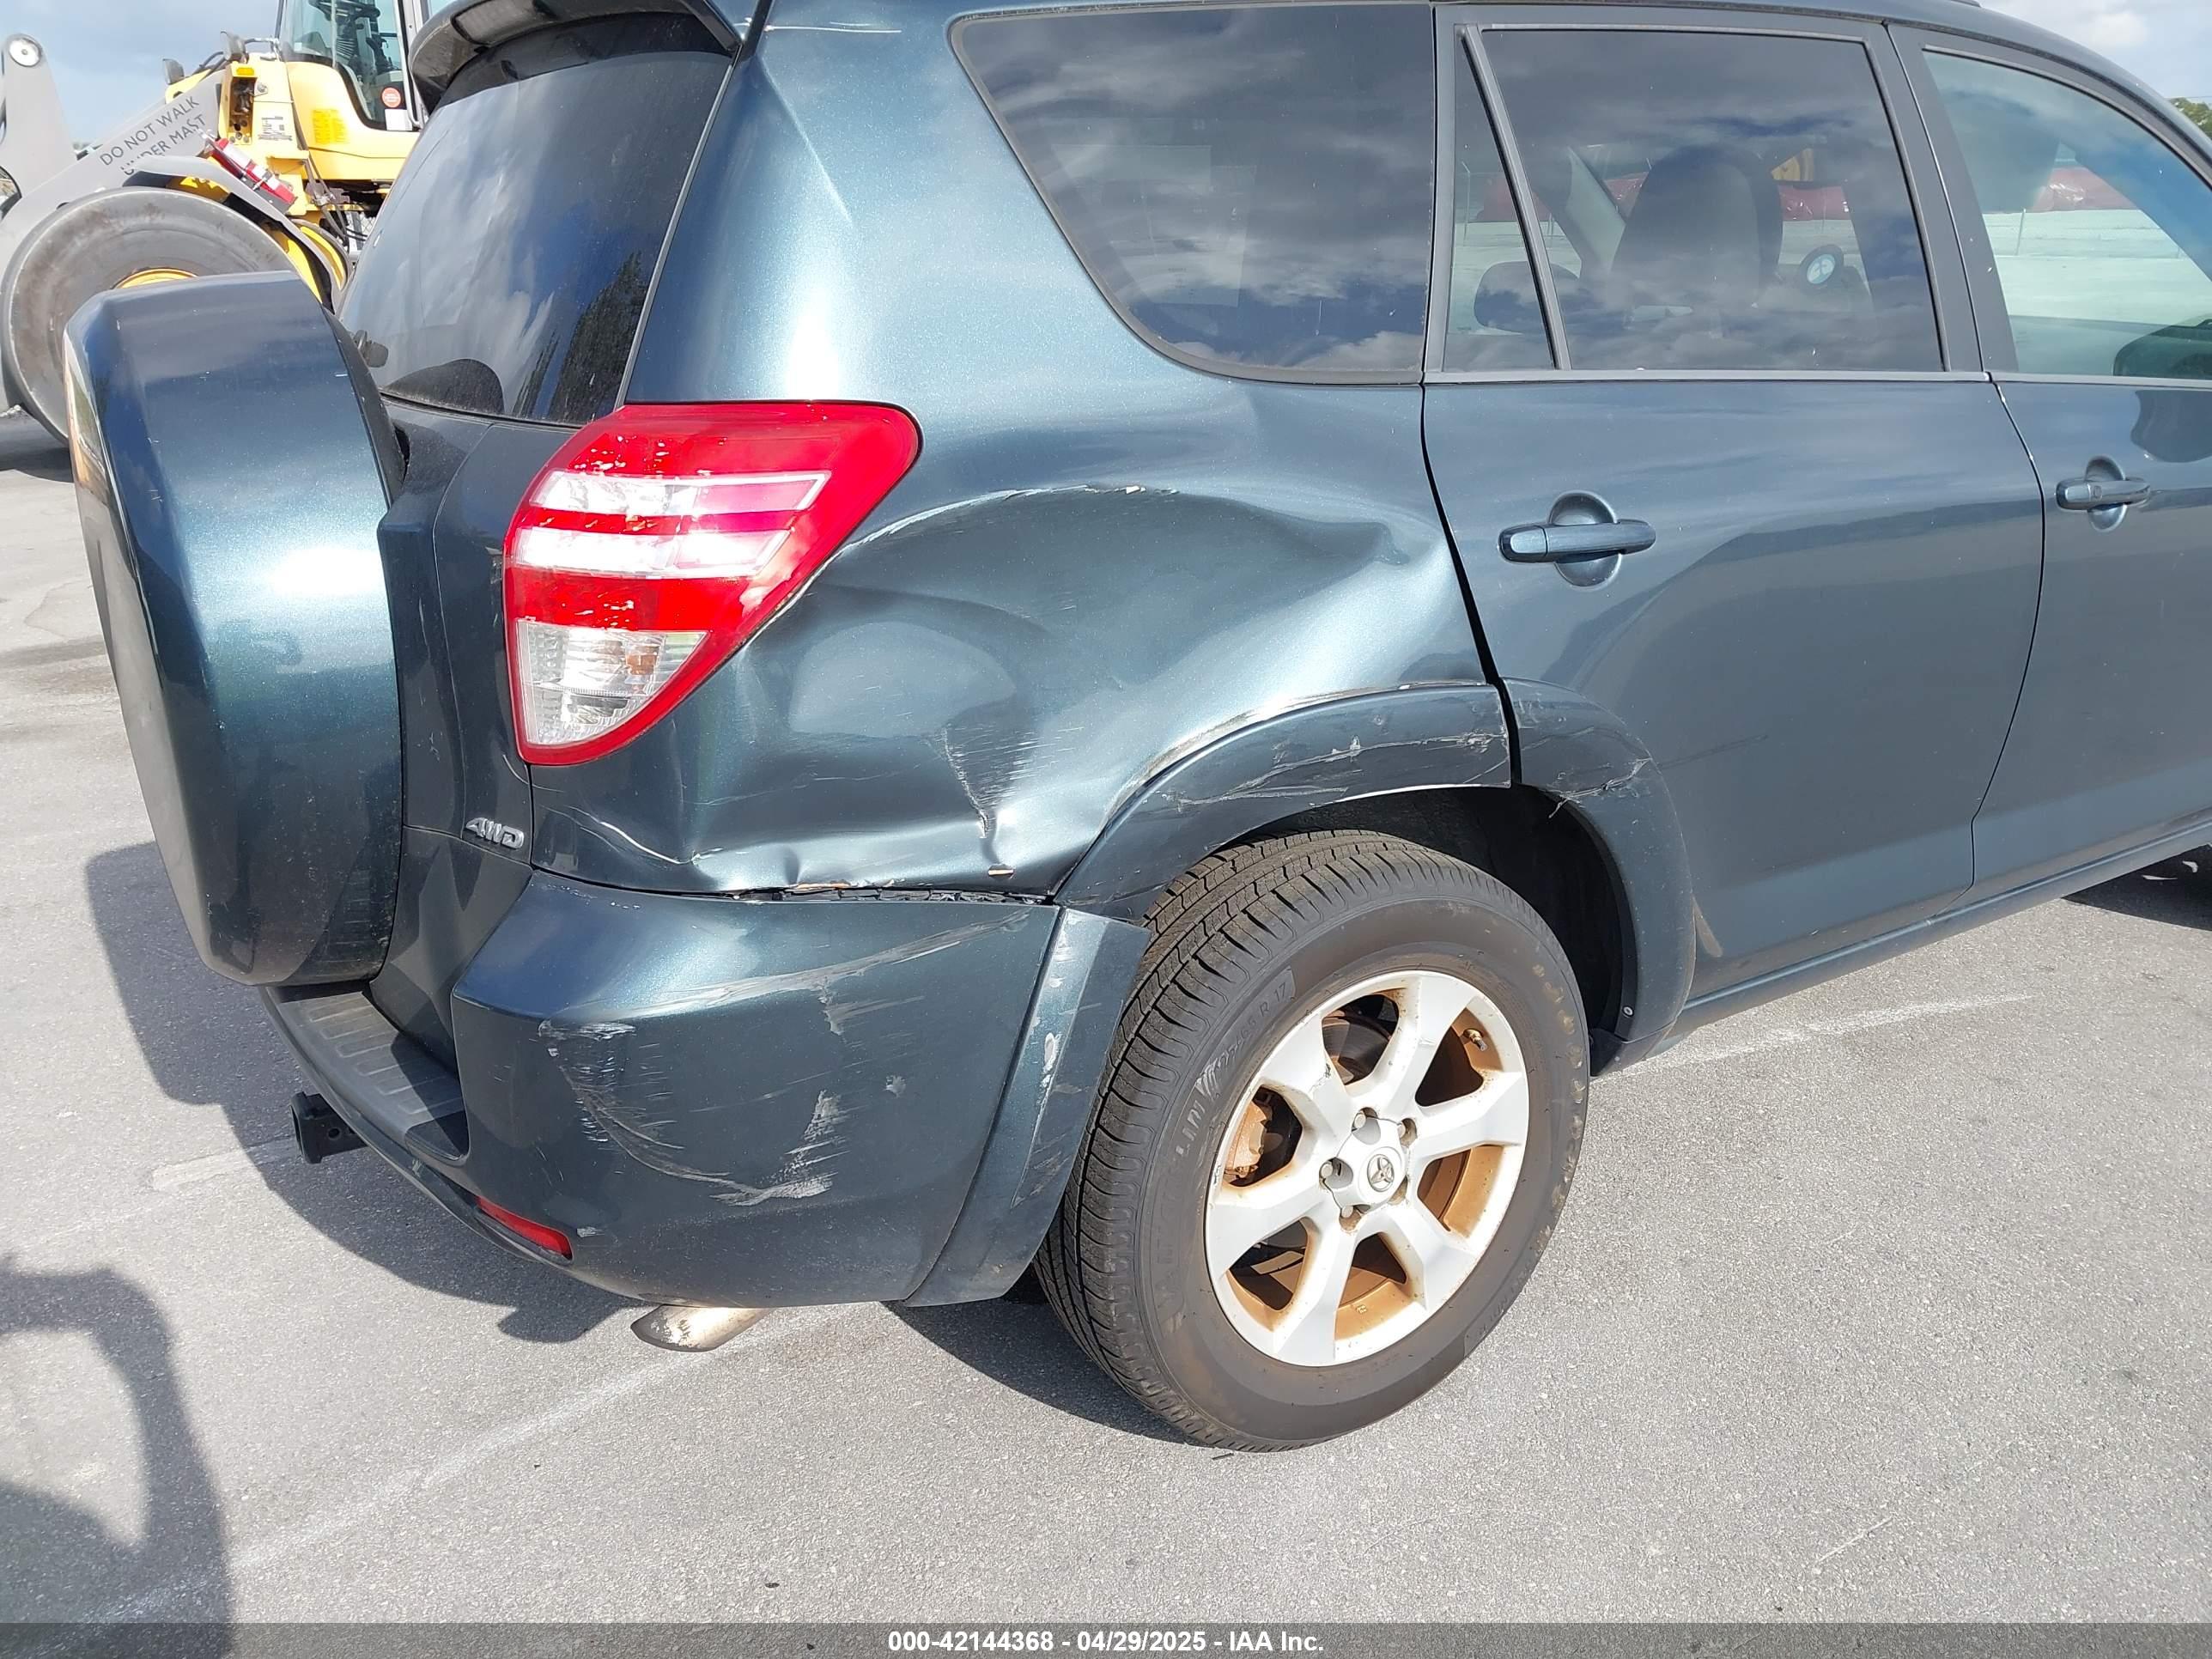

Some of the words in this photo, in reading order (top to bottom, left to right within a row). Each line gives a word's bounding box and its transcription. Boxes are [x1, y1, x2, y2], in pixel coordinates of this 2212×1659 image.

[100, 146, 124, 166] DO
[124, 123, 156, 150] NOT
[155, 96, 200, 128] WALK
[120, 140, 172, 176] UER
[168, 113, 206, 145] MAST
[465, 817, 525, 849] 4WD
[1259, 1000, 1270, 1018] R
[1273, 981, 1286, 1003] 17
